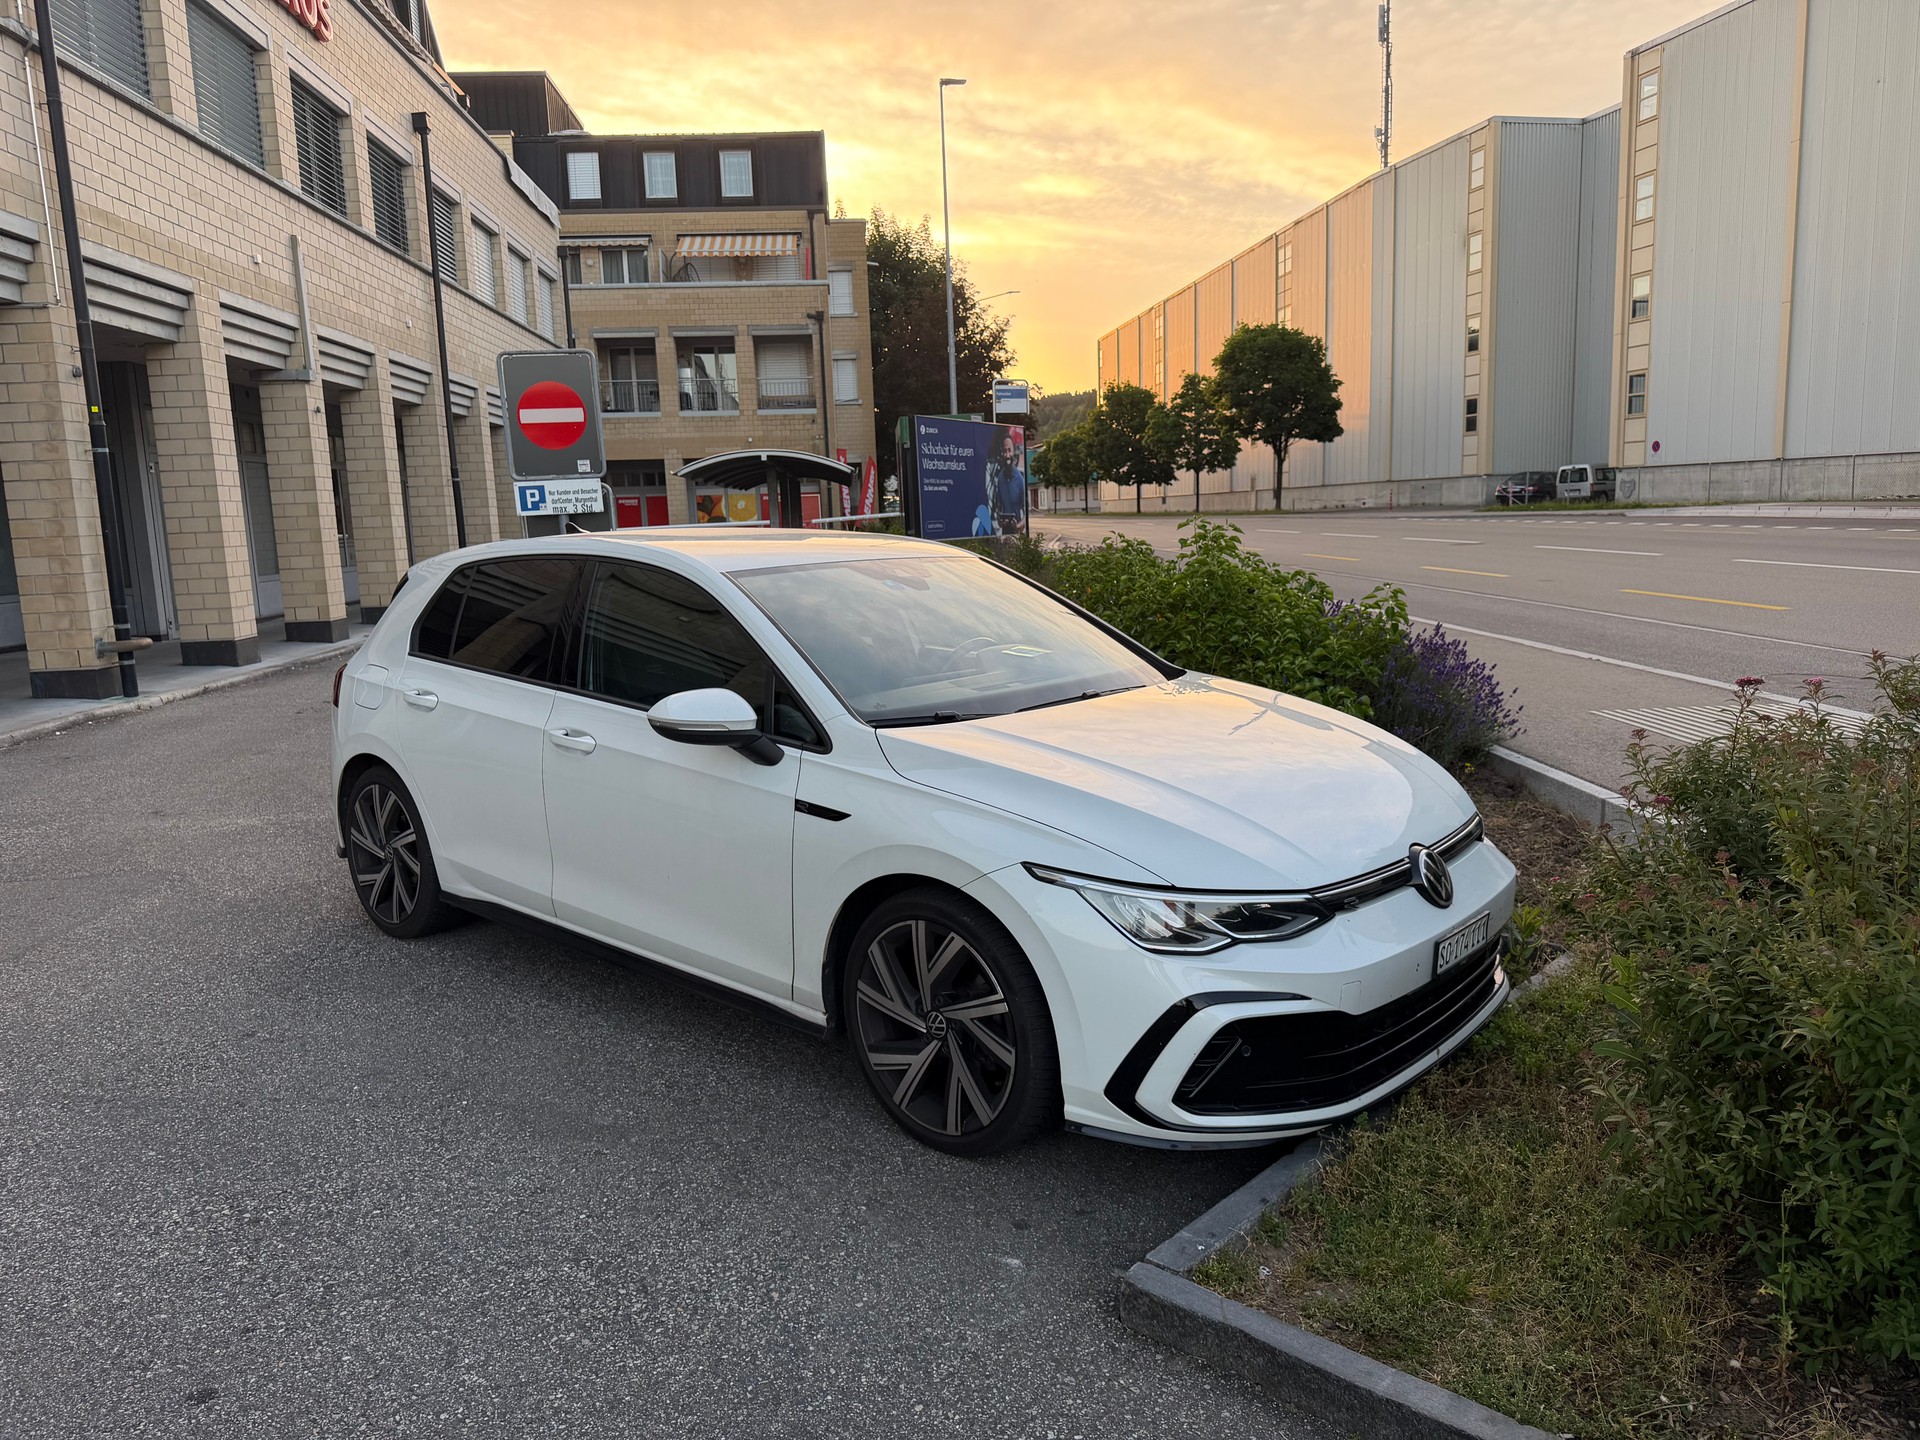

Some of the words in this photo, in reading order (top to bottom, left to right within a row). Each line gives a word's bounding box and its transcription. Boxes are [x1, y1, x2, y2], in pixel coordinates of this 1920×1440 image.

[921, 442, 949, 455] Sicherheit
[958, 447, 974, 456] euren
[922, 458, 966, 471] Wachstumskurs.
[525, 489, 540, 509] P
[575, 496, 598, 504] Murgenthal
[573, 504, 578, 513] 3
[581, 503, 596, 513] Std.
